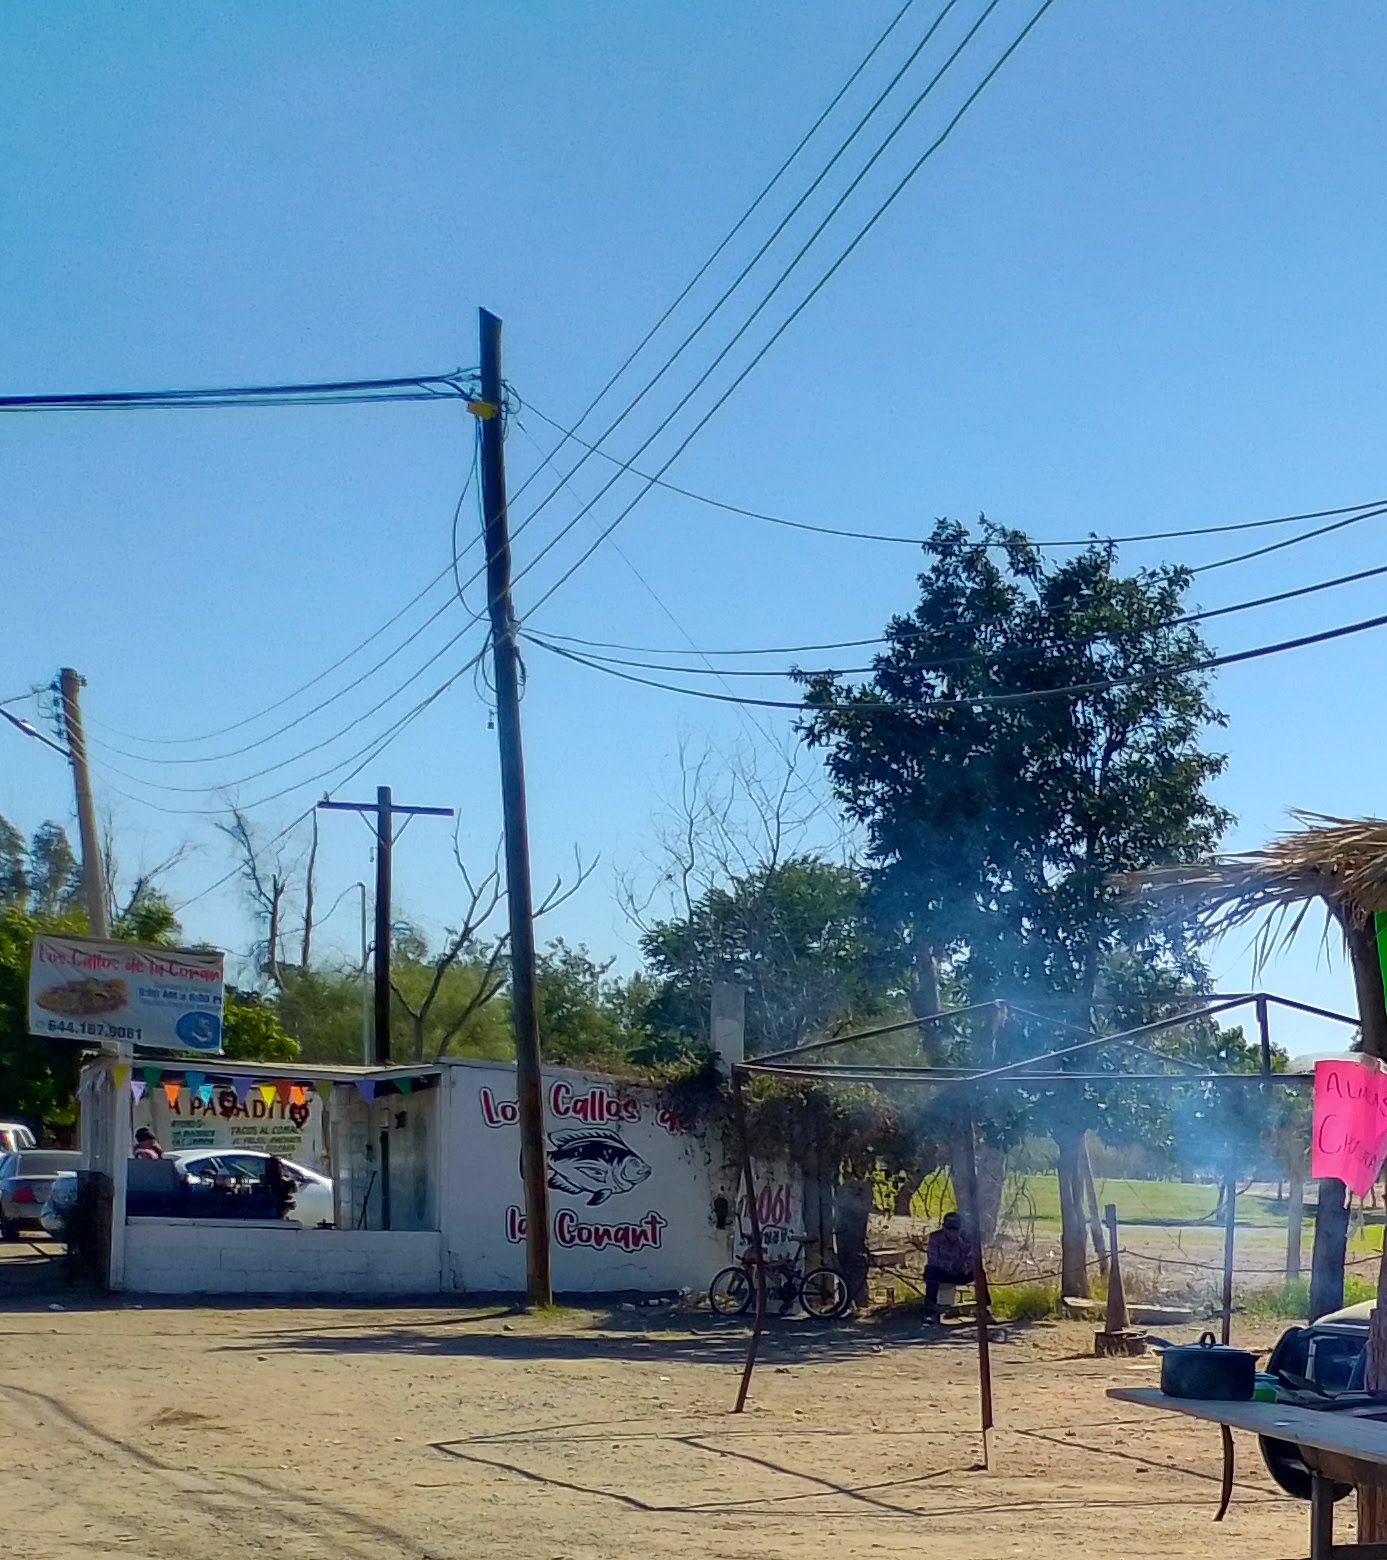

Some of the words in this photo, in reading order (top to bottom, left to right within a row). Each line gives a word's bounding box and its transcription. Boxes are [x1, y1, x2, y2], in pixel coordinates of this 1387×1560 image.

[480, 1087, 521, 1127] Lo
[550, 1081, 642, 1123] Callos
[556, 1209, 668, 1253] Conant
